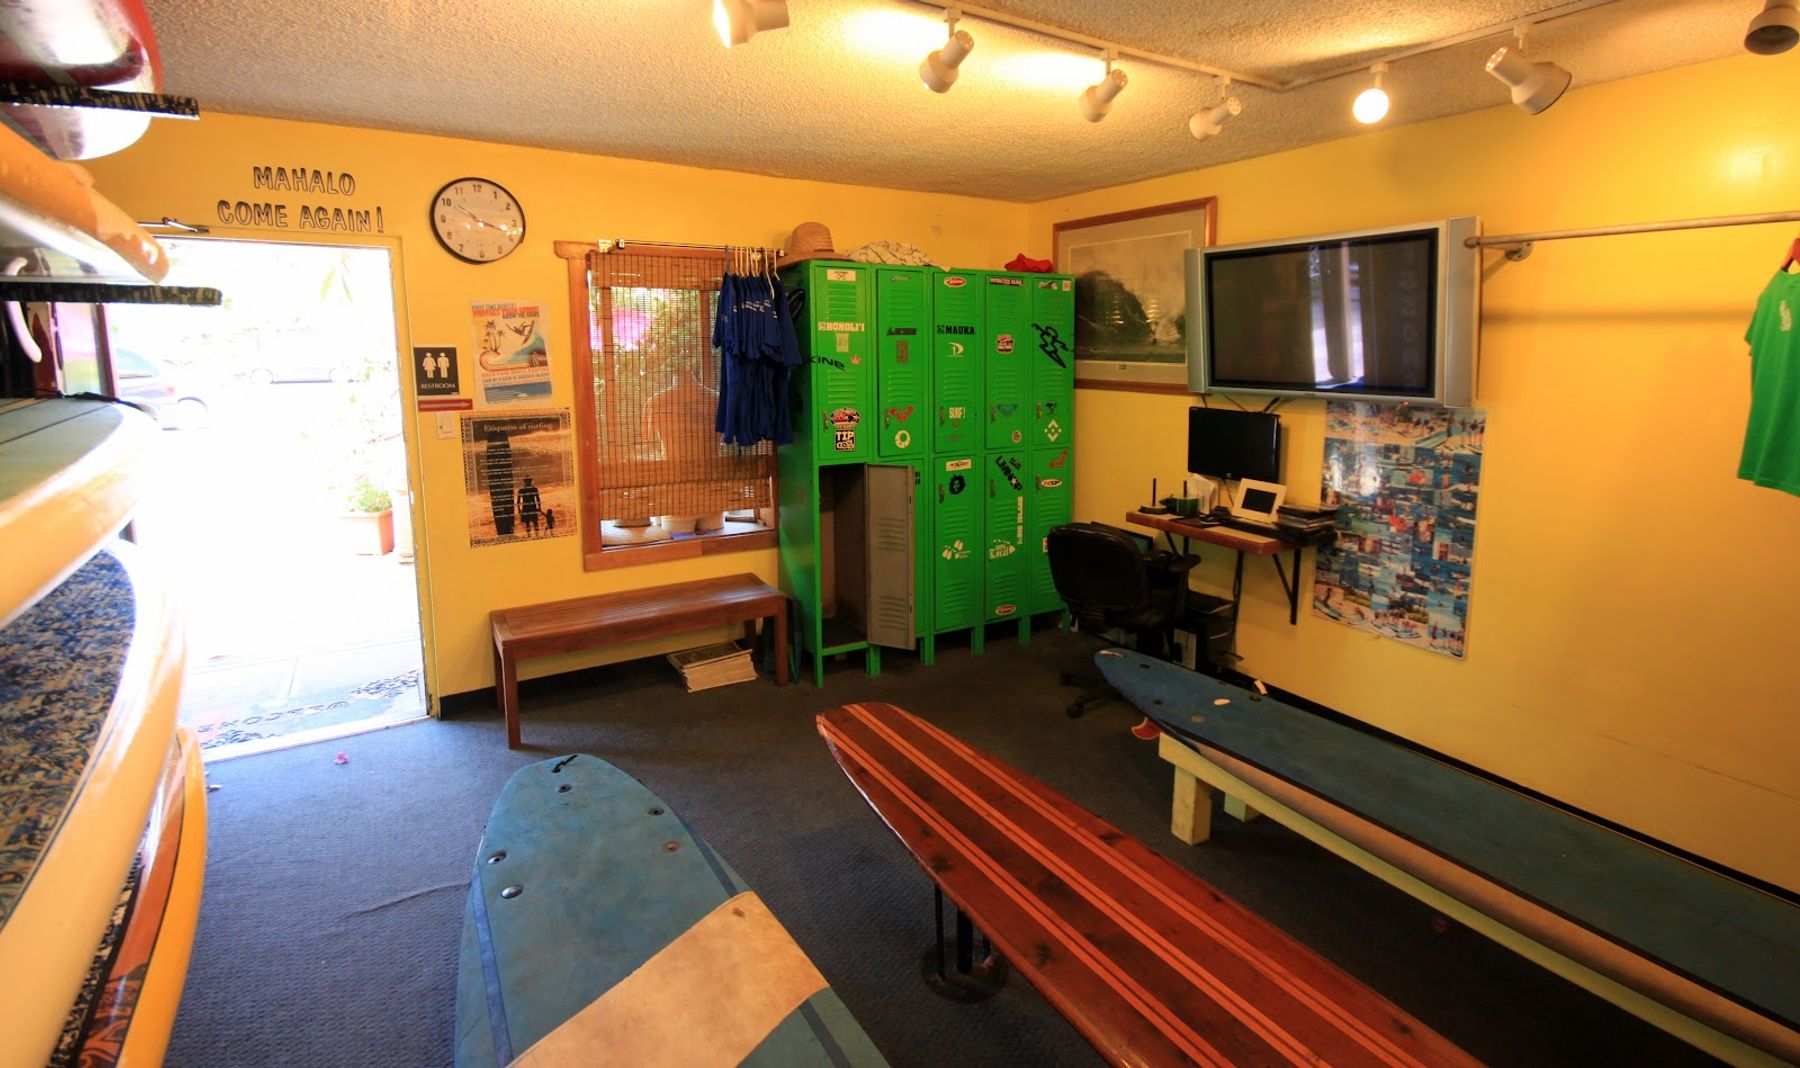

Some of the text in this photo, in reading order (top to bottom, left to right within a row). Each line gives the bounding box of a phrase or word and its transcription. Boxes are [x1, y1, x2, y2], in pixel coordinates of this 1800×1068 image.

[253, 166, 356, 196] MAHALO
[454, 186, 463, 196] 11
[472, 184, 482, 193] 12
[441, 198, 451, 206] 10
[505, 202, 511, 211] 2
[217, 199, 384, 234] COME AGAIN!
[945, 325, 975, 335] MAUKA
[483, 424, 517, 432] Etiquette
[528, 422, 553, 431] surfing
